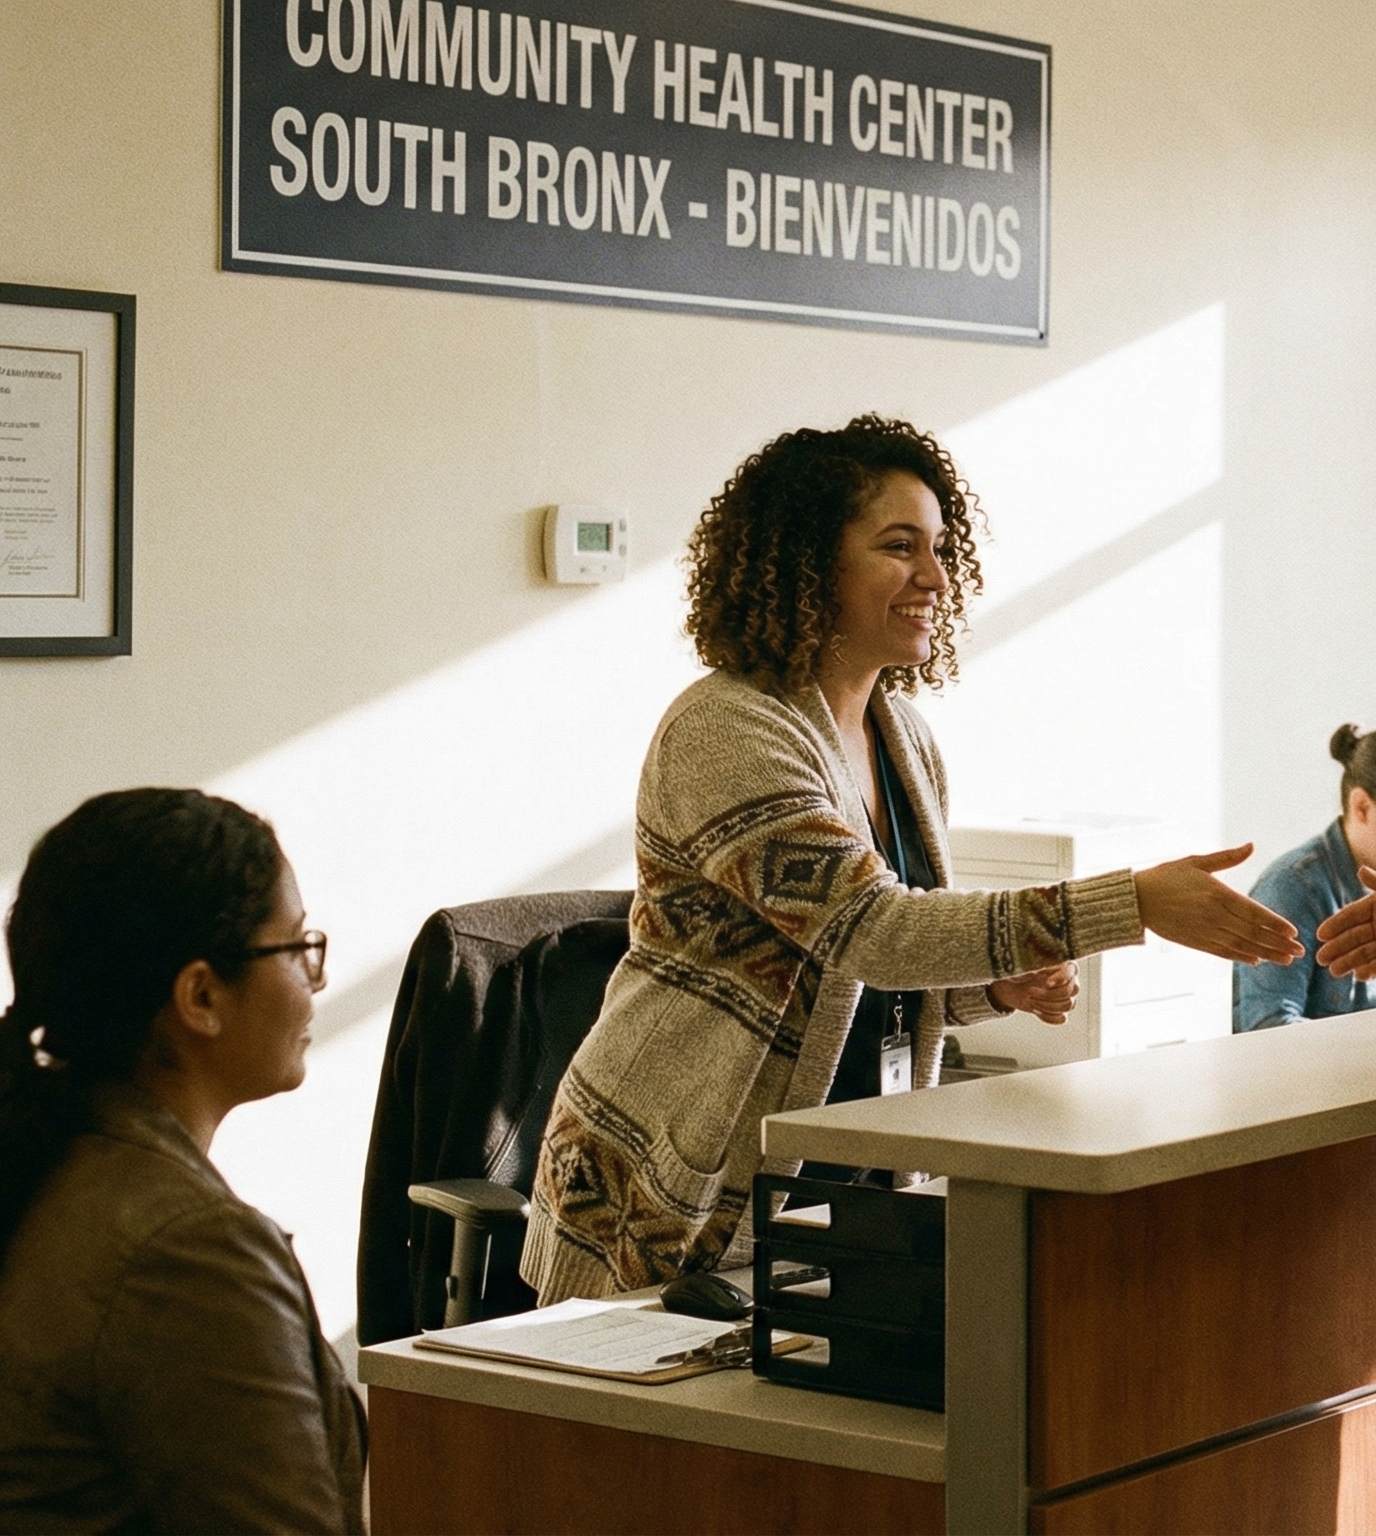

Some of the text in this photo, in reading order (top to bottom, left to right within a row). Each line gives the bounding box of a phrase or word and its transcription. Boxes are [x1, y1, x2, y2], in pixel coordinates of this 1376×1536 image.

[286, 0, 1014, 173] COMMUNITY HEALTH CENTER
[270, 106, 1022, 280] SOUTH BRONX - BIENVENIDOS
